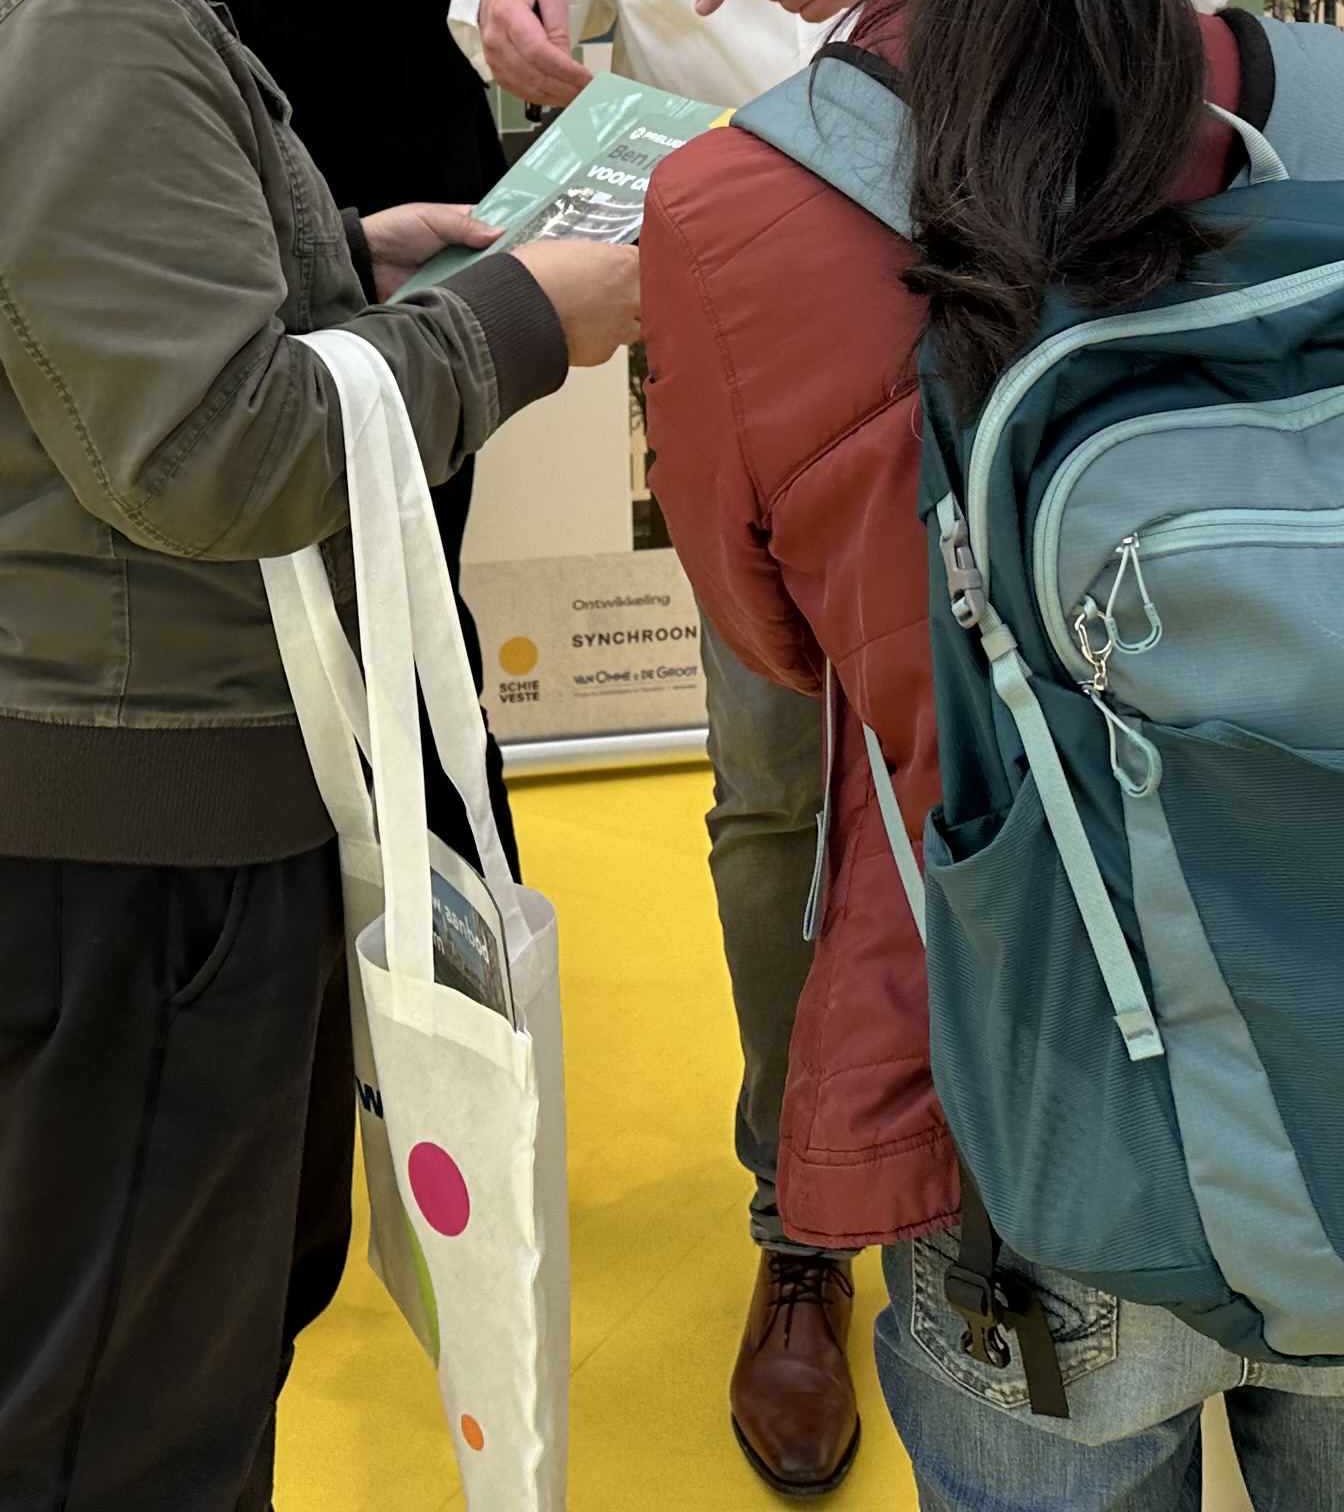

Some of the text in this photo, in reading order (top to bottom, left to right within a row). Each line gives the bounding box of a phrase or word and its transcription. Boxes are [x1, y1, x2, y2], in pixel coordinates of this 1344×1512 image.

[608, 144, 649, 167] Ben
[587, 165, 636, 187] voor
[571, 593, 671, 611] Ontwikkeling
[572, 626, 697, 648] SYNCHROON
[499, 680, 540, 694] SCHIE
[499, 692, 540, 704] VESTE
